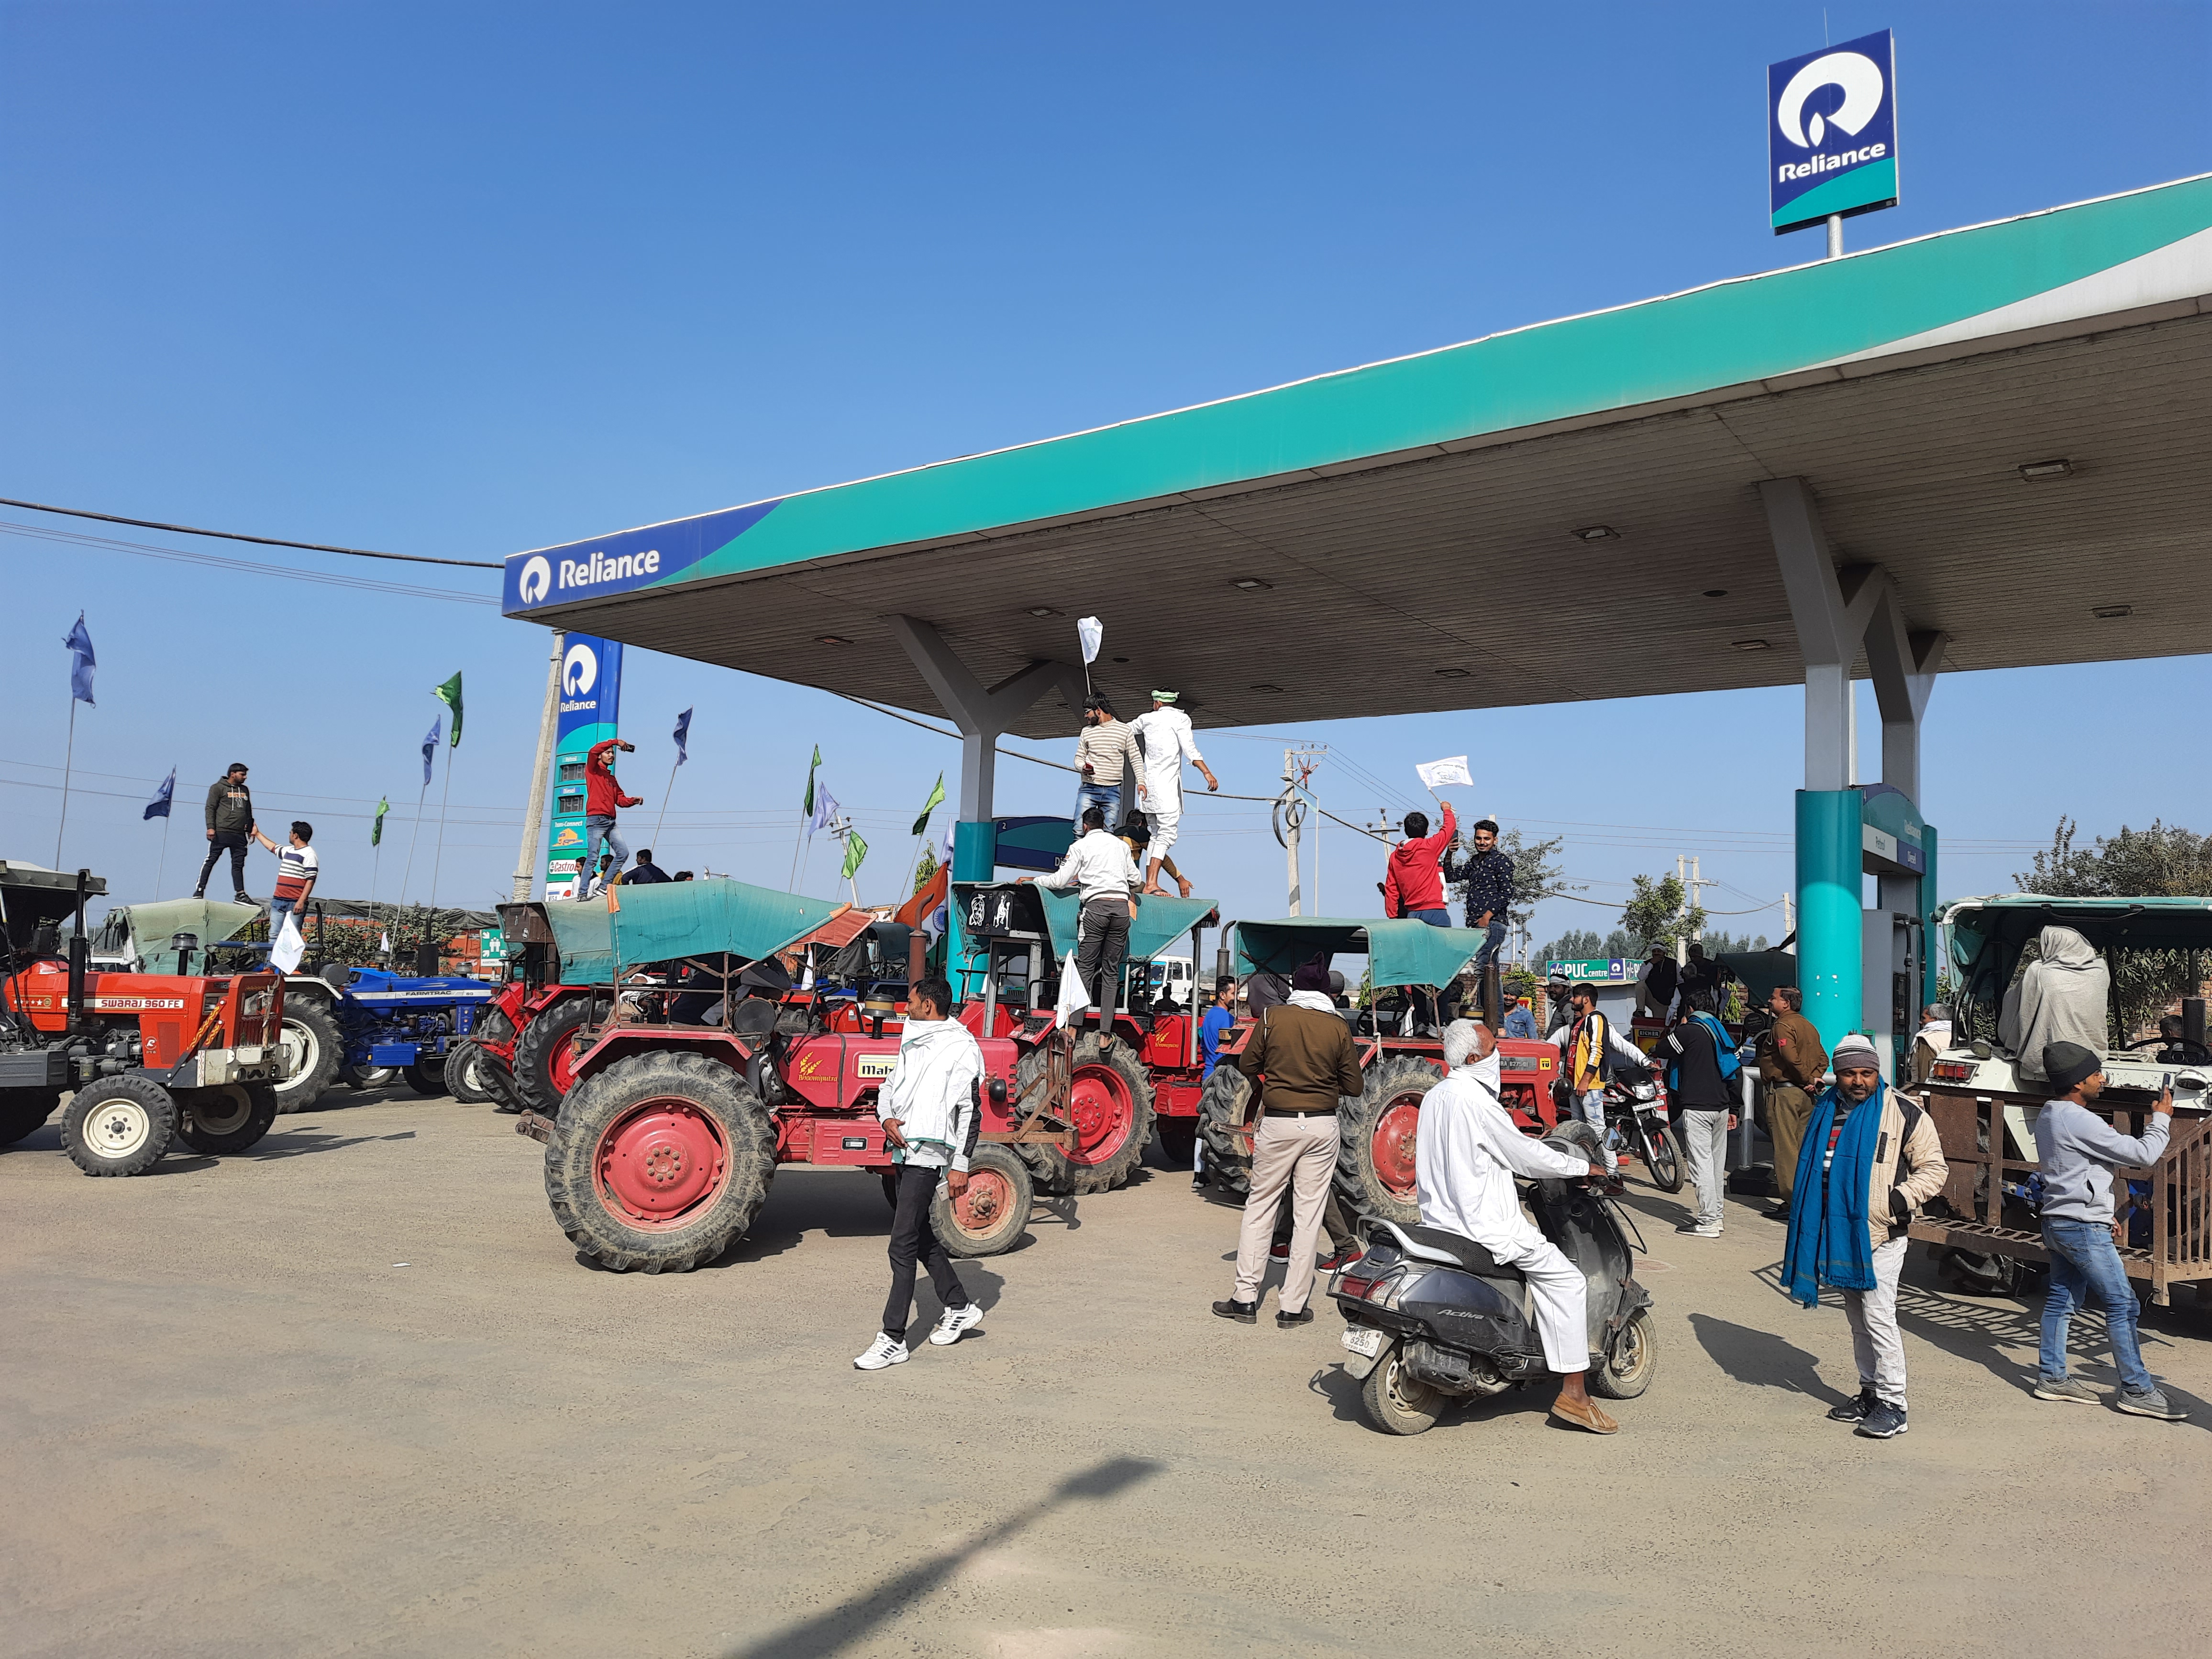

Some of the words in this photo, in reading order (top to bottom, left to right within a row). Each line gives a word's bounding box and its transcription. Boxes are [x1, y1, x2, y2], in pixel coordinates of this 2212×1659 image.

[1779, 144, 1886, 183] Reliance
[559, 550, 660, 589] Reliance
[561, 700, 597, 713] Reliance
[1876, 836, 1885, 851] Petrol
[1565, 963, 1588, 977] PUC
[1436, 1309, 1485, 1320] Activa
[1350, 1337, 1370, 1349] 6250
